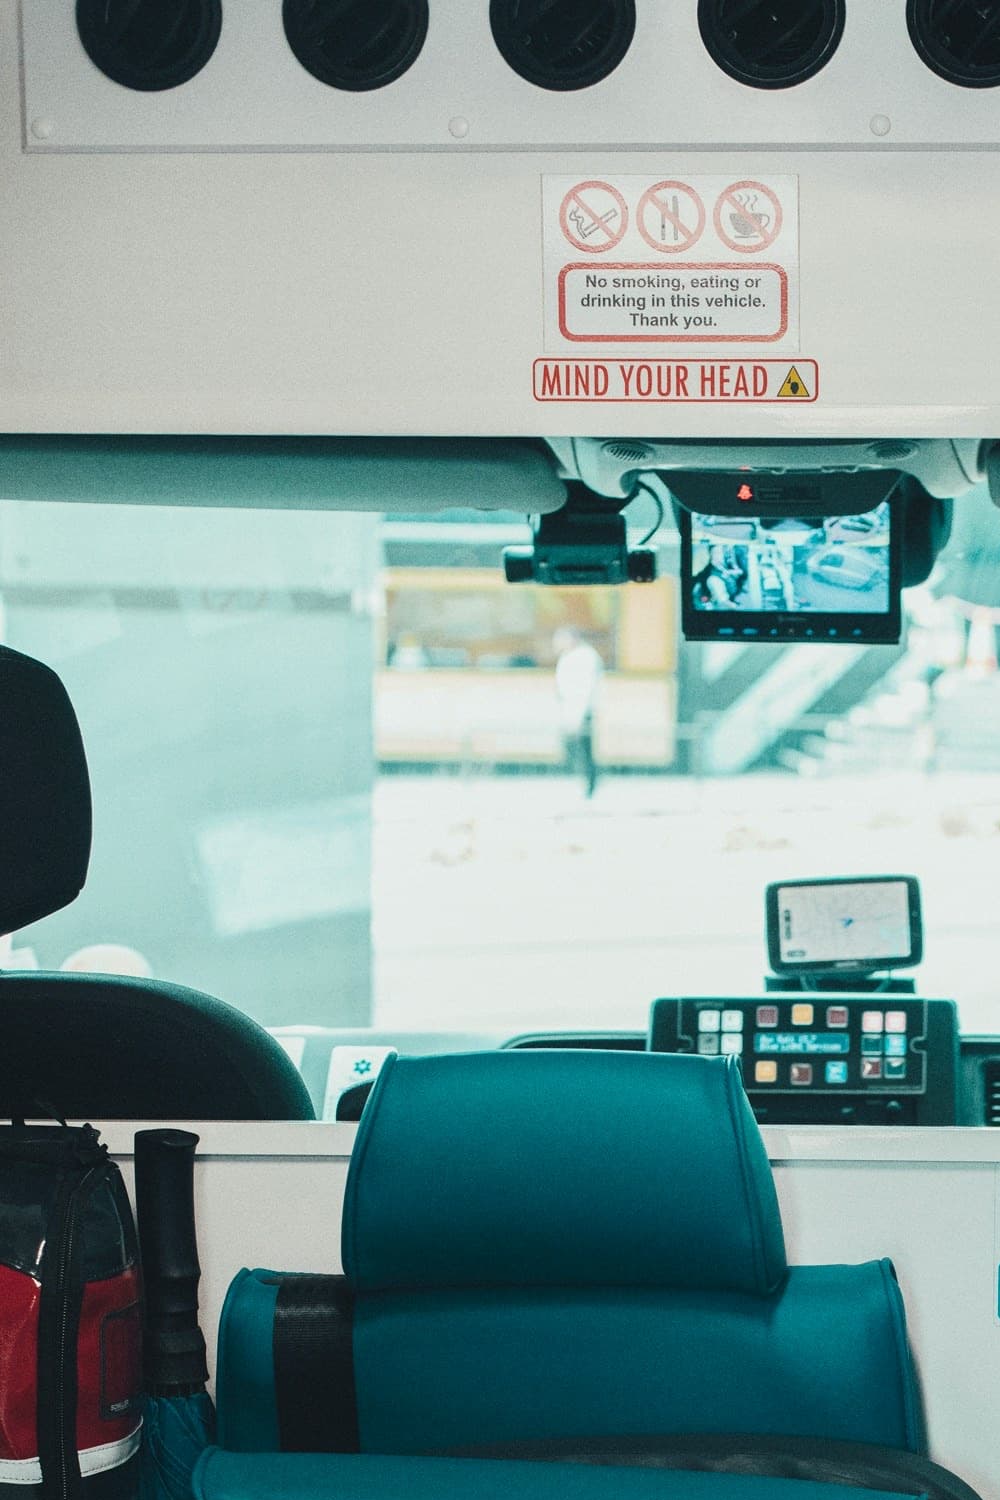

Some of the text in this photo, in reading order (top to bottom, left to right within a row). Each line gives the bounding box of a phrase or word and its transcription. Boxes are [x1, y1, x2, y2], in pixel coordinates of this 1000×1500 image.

[585, 274, 762, 291] No smoking, eating or
[580, 293, 766, 309] drinking in this vehicle.
[629, 312, 717, 330] Thank you.
[541, 364, 769, 397] MIND YOUR HEAD
